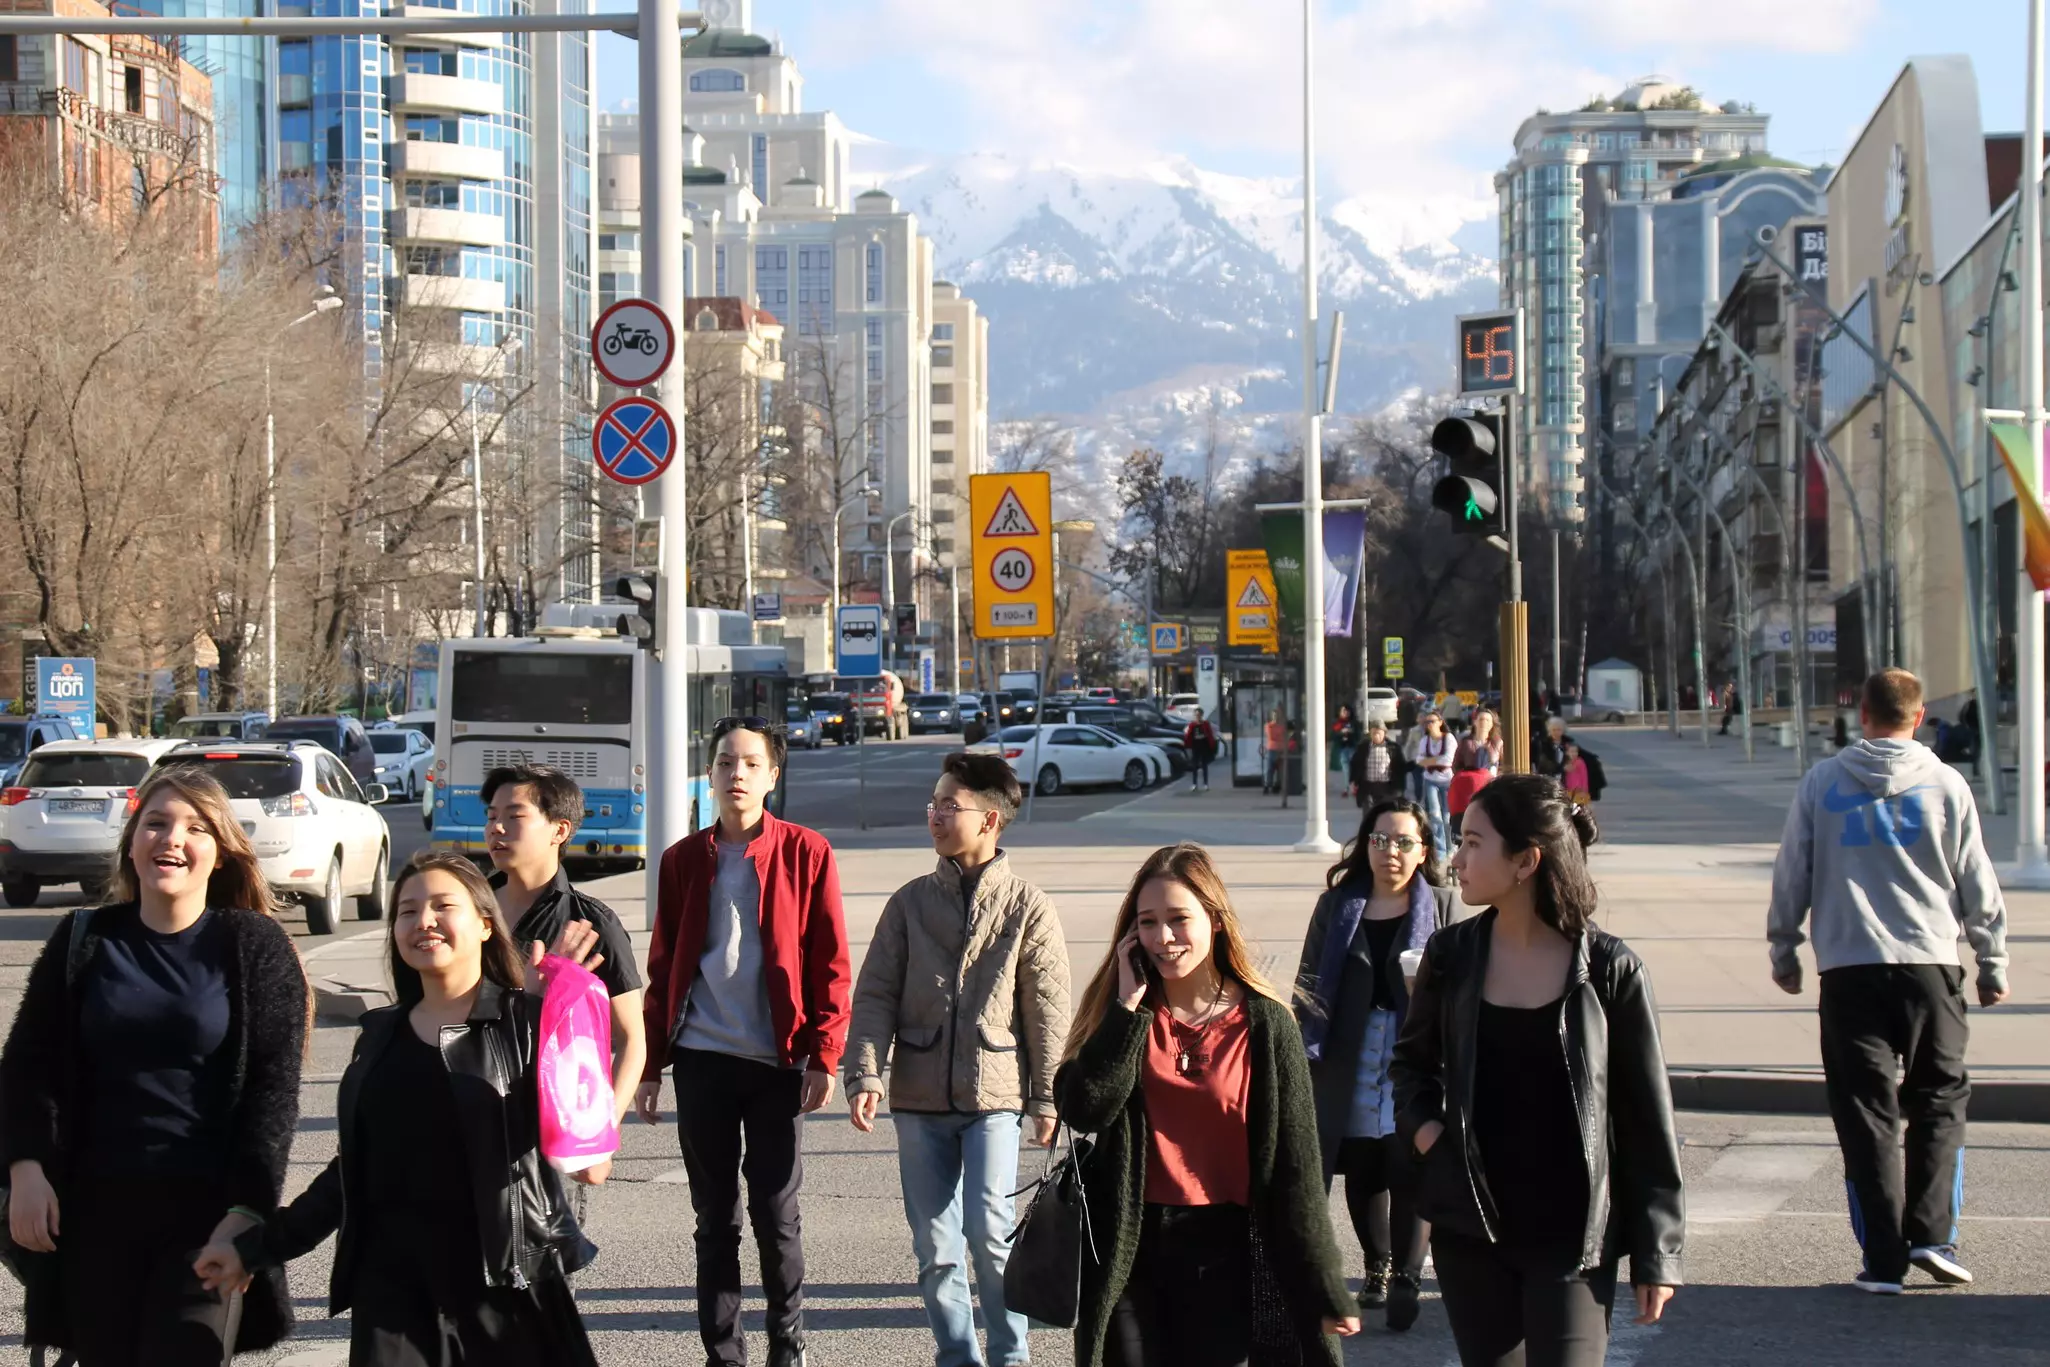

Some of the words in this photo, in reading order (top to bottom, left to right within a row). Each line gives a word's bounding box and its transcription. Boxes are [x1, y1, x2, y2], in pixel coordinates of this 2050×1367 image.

[1802, 231, 1828, 254] Бі
[1465, 326, 1514, 380] 45
[1000, 560, 1026, 580] 40
[50, 681, 84, 698] ЦОП
